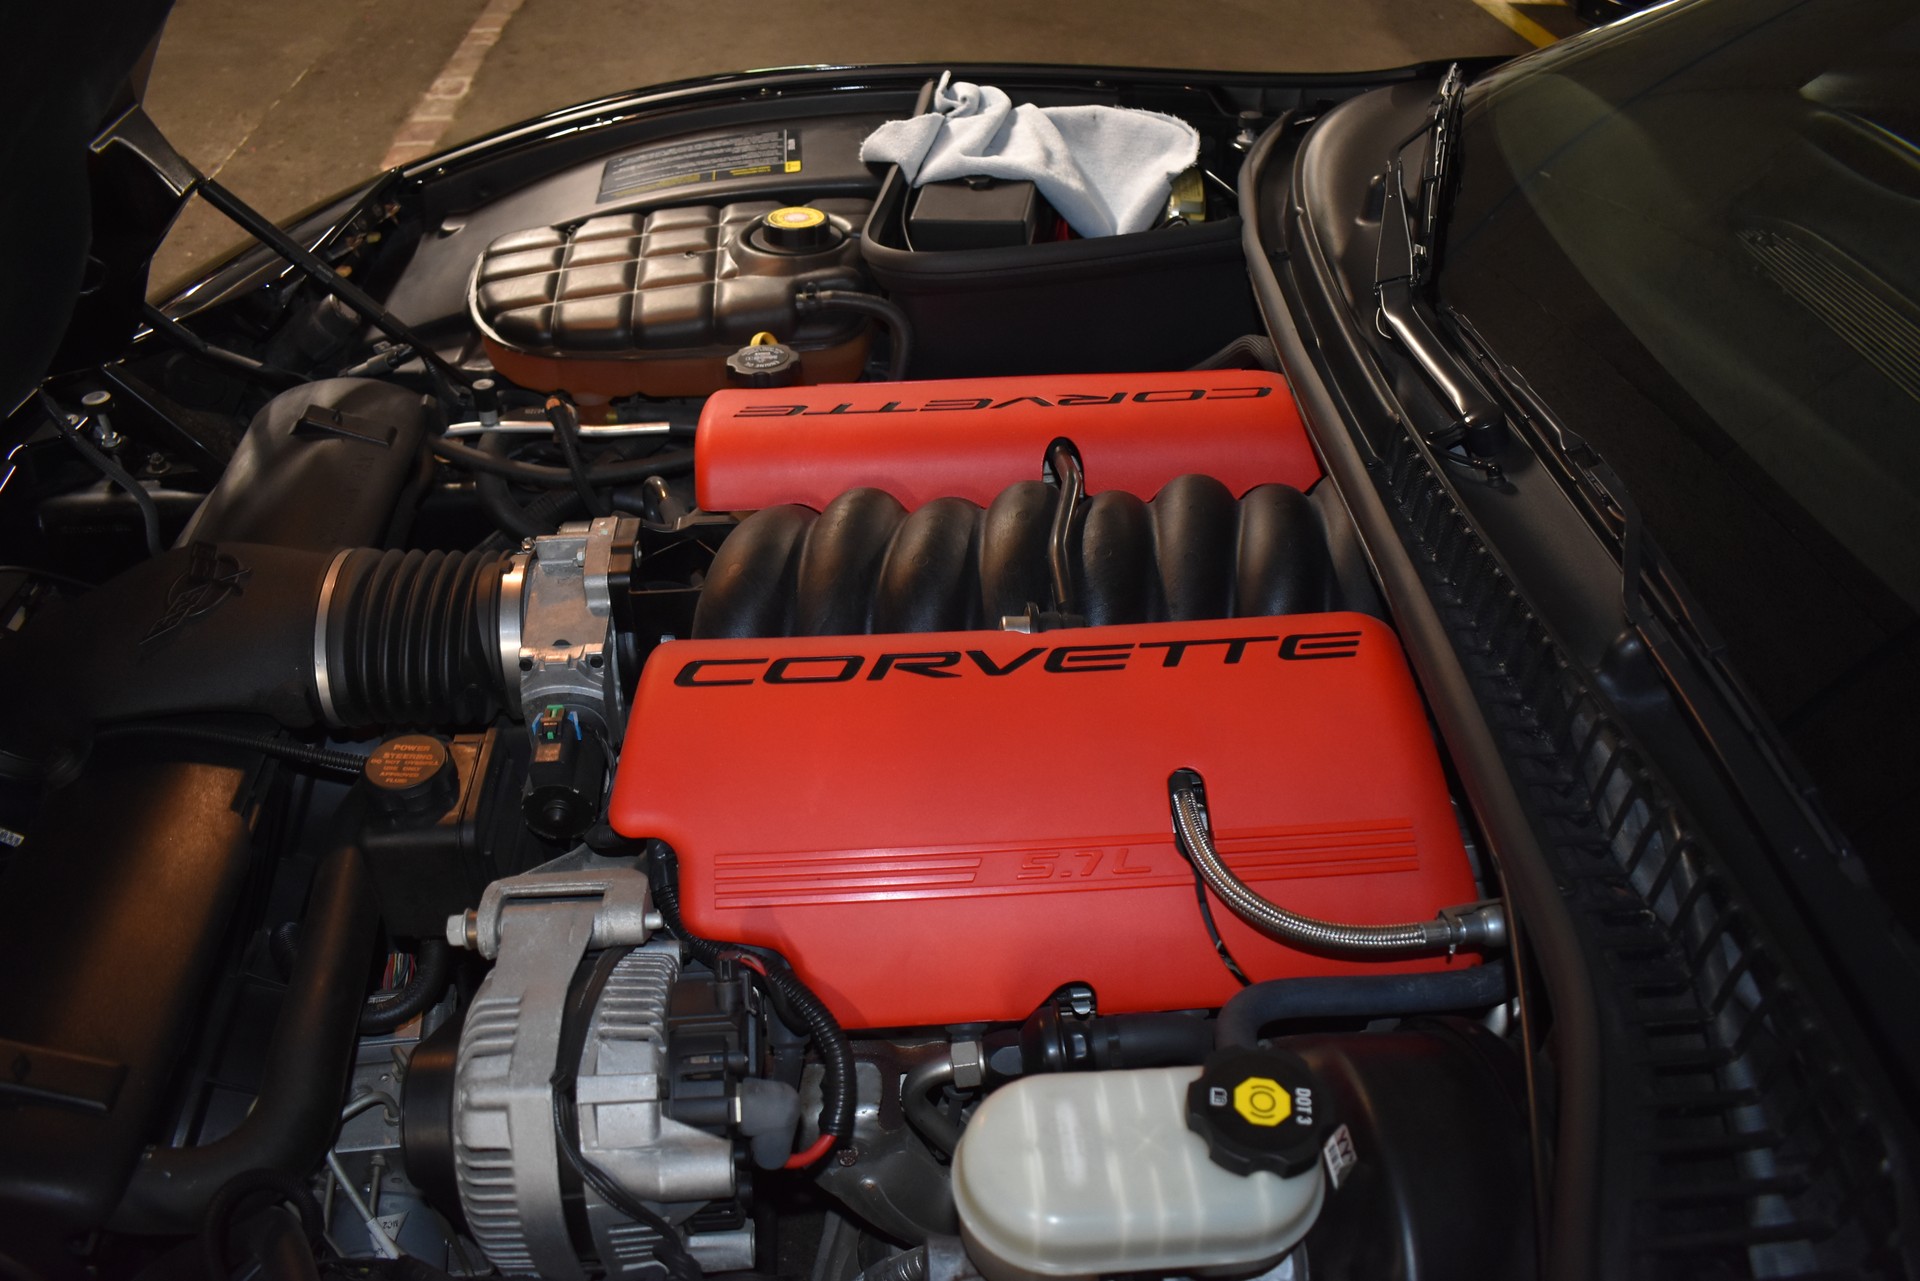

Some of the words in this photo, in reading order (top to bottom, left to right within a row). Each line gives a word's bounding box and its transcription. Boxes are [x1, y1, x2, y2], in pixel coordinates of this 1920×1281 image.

[733, 386, 1272, 418] CORVETTE
[674, 631, 1361, 687] CORVETTE
[1017, 846, 1153, 882] 5.7L
[1294, 1087, 1312, 1114] DOT
[1296, 1116, 1312, 1125] 3
